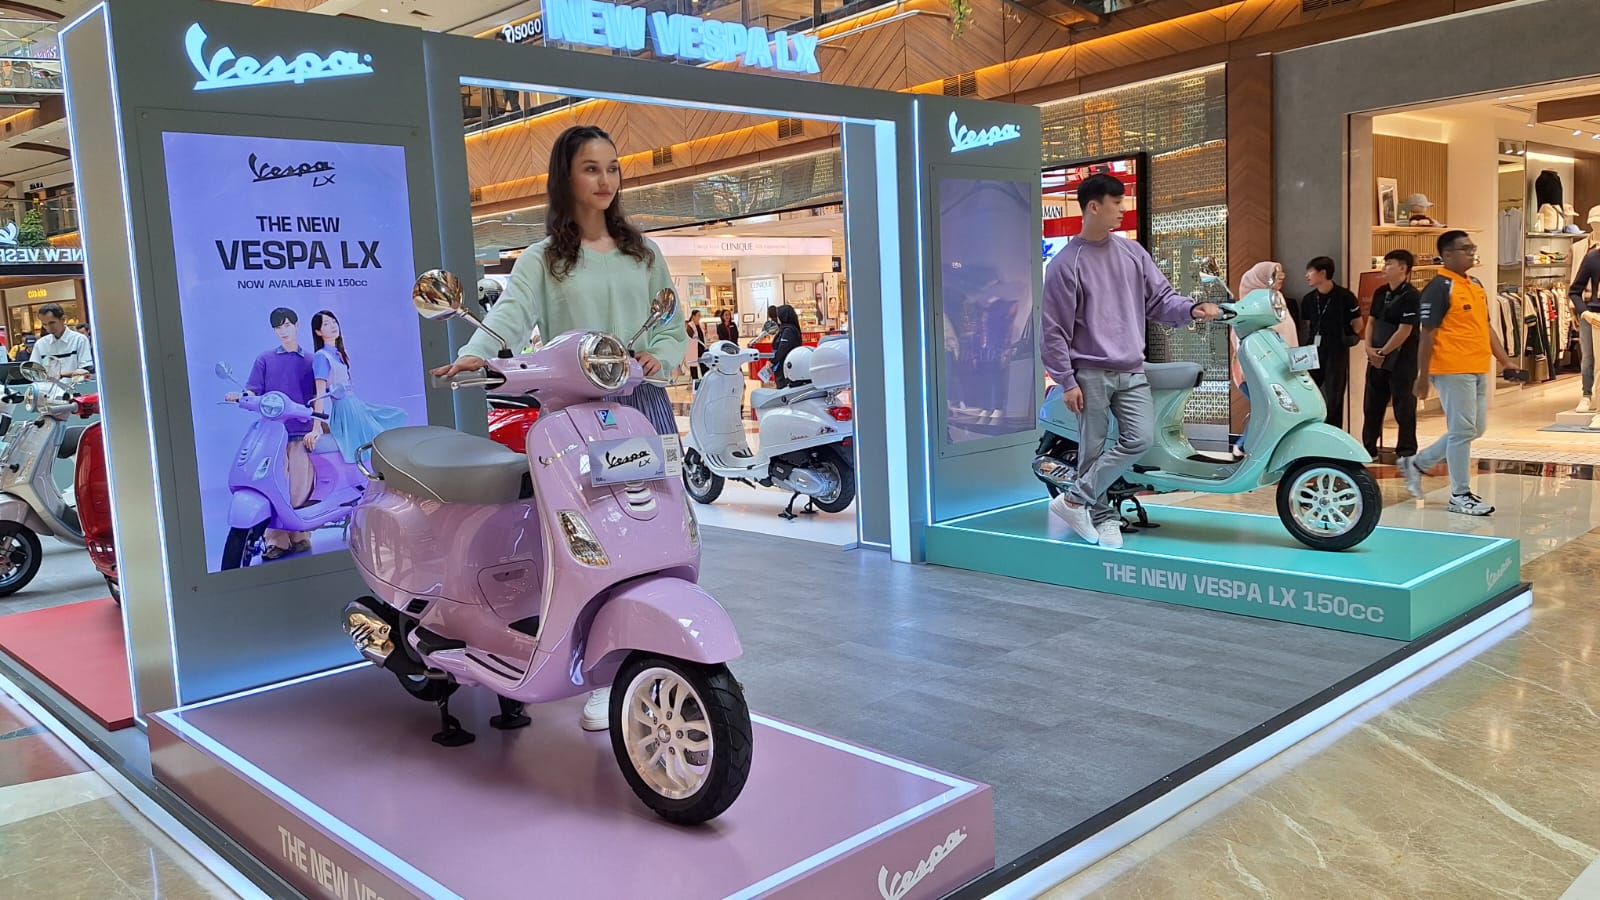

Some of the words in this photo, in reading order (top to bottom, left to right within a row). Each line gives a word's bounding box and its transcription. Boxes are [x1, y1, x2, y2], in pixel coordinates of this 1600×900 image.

[515, 18, 542, 41] SOGO
[545, 0, 647, 51] NEW
[651, 11, 773, 68] VESPA
[774, 30, 821, 74] LX
[185, 22, 374, 91] Vespa
[948, 110, 1022, 153] Vespa
[248, 152, 336, 183] Vespa
[312, 173, 336, 188] LX
[256, 215, 292, 232] THE
[297, 216, 340, 233] NEW
[215, 239, 332, 271] VESPA
[340, 240, 382, 270] LX
[720, 242, 753, 252] CLINIQUE
[237, 279, 265, 290] NOW
[268, 278, 323, 289] AVAILABLE
[324, 278, 336, 288] IN
[337, 278, 368, 288] 150cc
[605, 450, 651, 470] Vespa
[638, 457, 651, 468] LX
[1102, 562, 1137, 584] THE
[1141, 567, 1187, 591] NEW
[1193, 574, 1263, 603] VESPA
[1268, 585, 1297, 609] LX
[1303, 590, 1385, 623] 150cc
[278, 824, 308, 874] THE
[309, 847, 349, 900] NEW
[877, 827, 968, 900] Vespa
